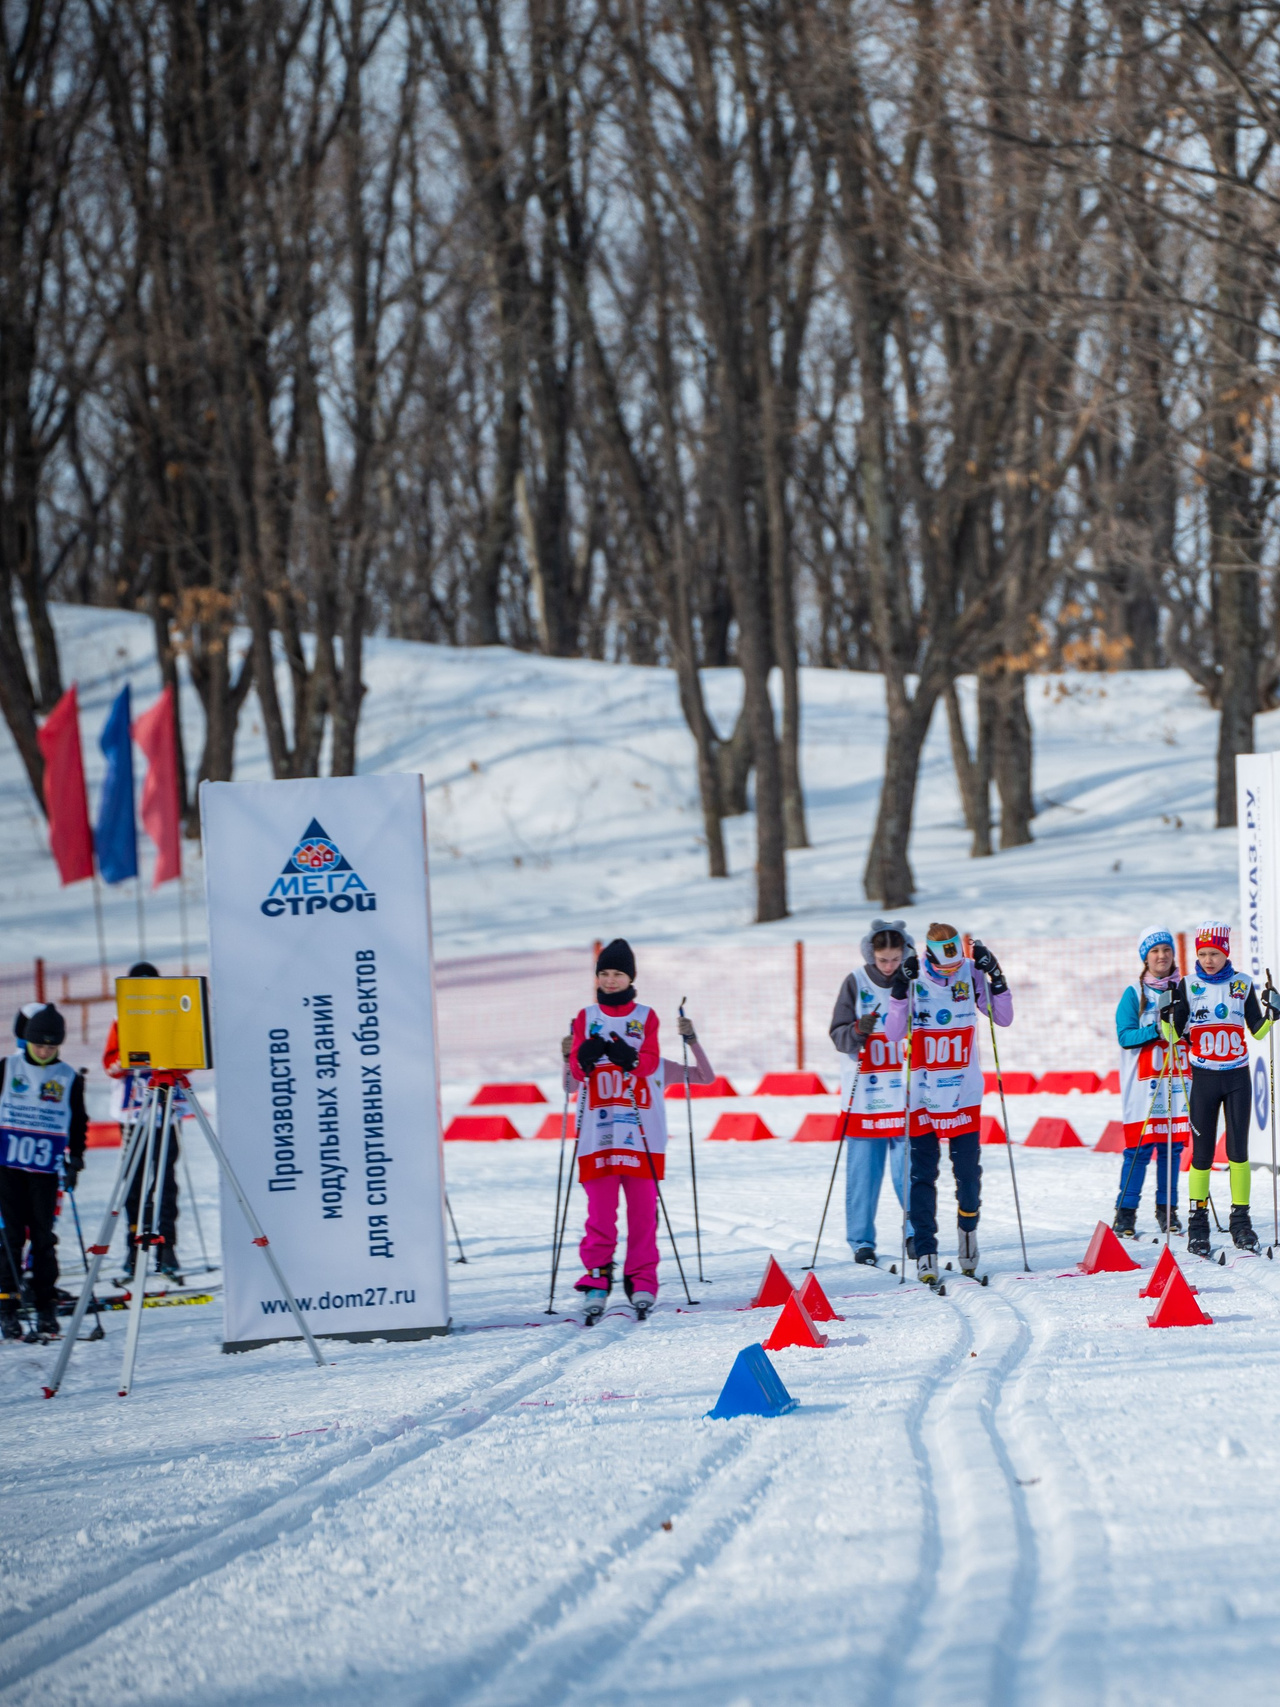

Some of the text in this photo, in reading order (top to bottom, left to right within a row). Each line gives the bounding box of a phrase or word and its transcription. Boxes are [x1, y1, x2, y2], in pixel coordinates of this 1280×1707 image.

[268, 872, 368, 897] МЕГА
[261, 892, 376, 917] СТРОЙ
[924, 1035, 968, 1064] 001 1
[1199, 1031, 1244, 1057] 009
[269, 1027, 303, 1192] Производство
[303, 994, 348, 1220] модульных зданий
[353, 948, 394, 1258] для спортивных объектов
[640, 1088, 647, 1104] 1
[7, 1134, 53, 1167] 103
[261, 1287, 415, 1314] www.dom27.ru
